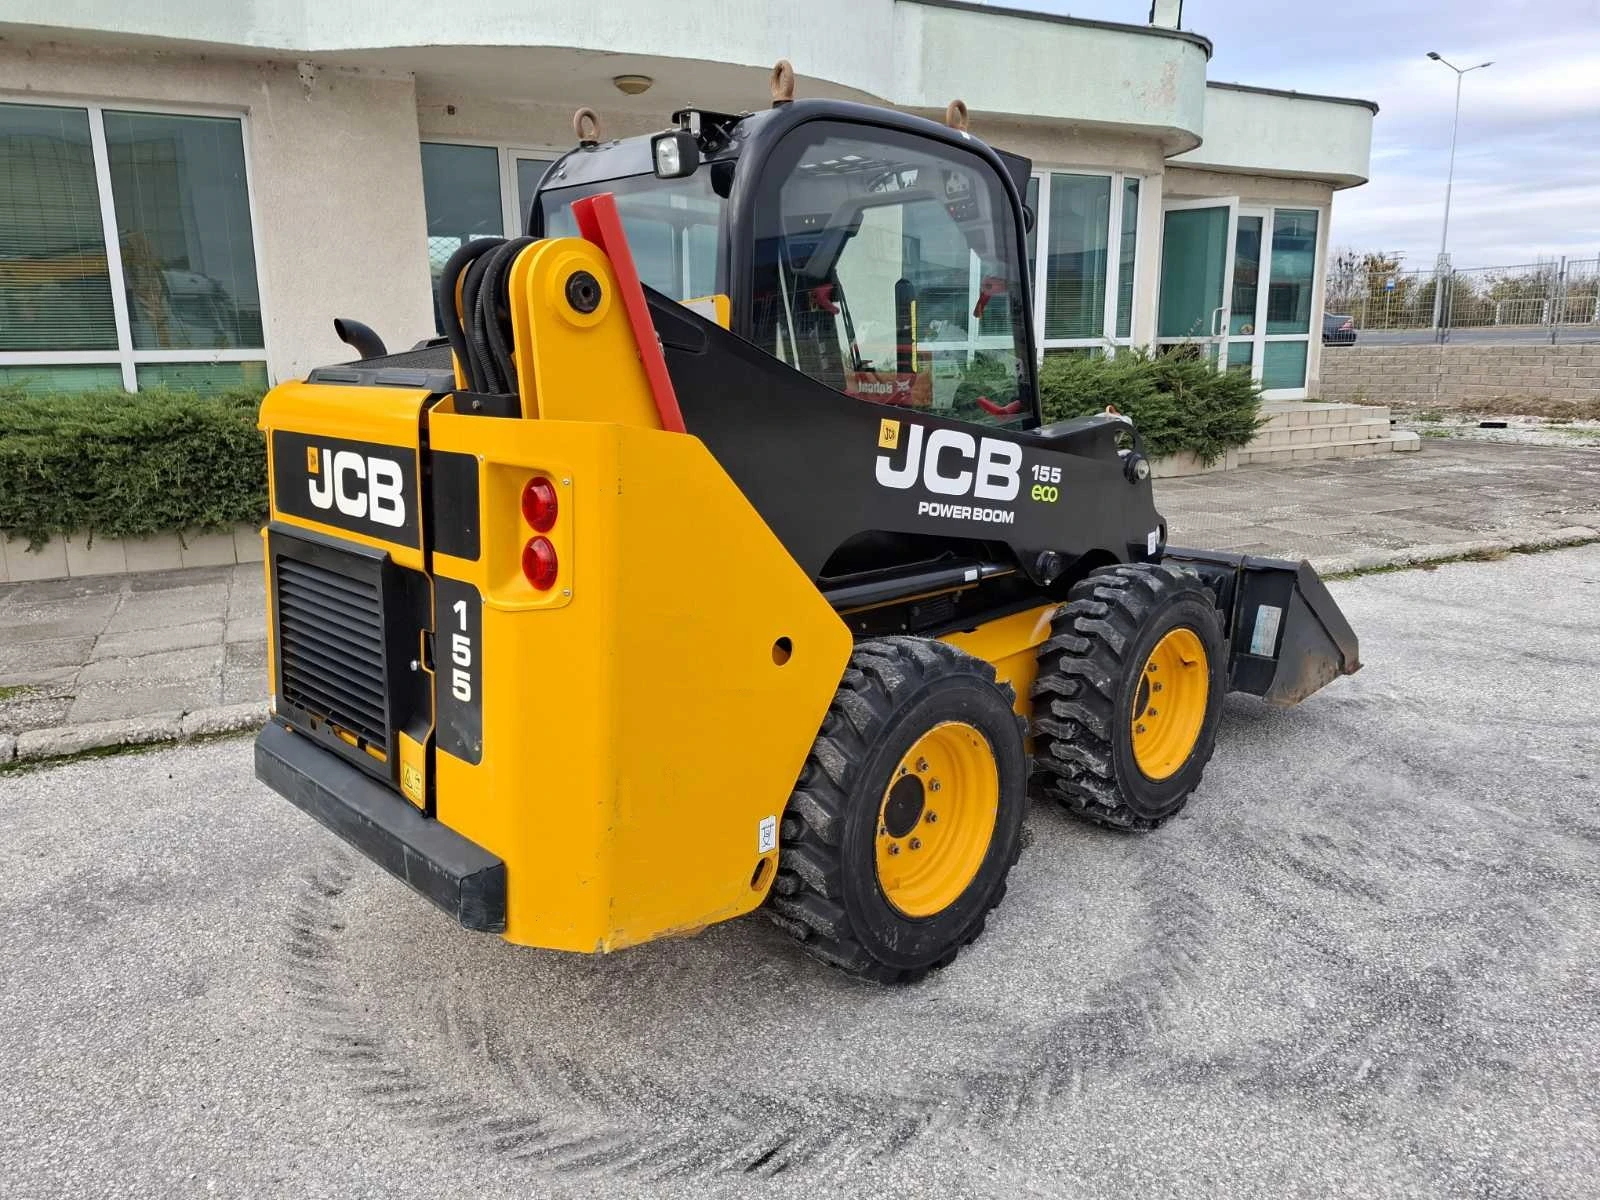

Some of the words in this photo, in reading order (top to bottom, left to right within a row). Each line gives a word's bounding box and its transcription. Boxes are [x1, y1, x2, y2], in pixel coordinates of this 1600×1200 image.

[876, 424, 1022, 501] JCB
[1031, 464, 1062, 484] 155
[308, 448, 405, 527] JCB
[1031, 485, 1058, 502] eco
